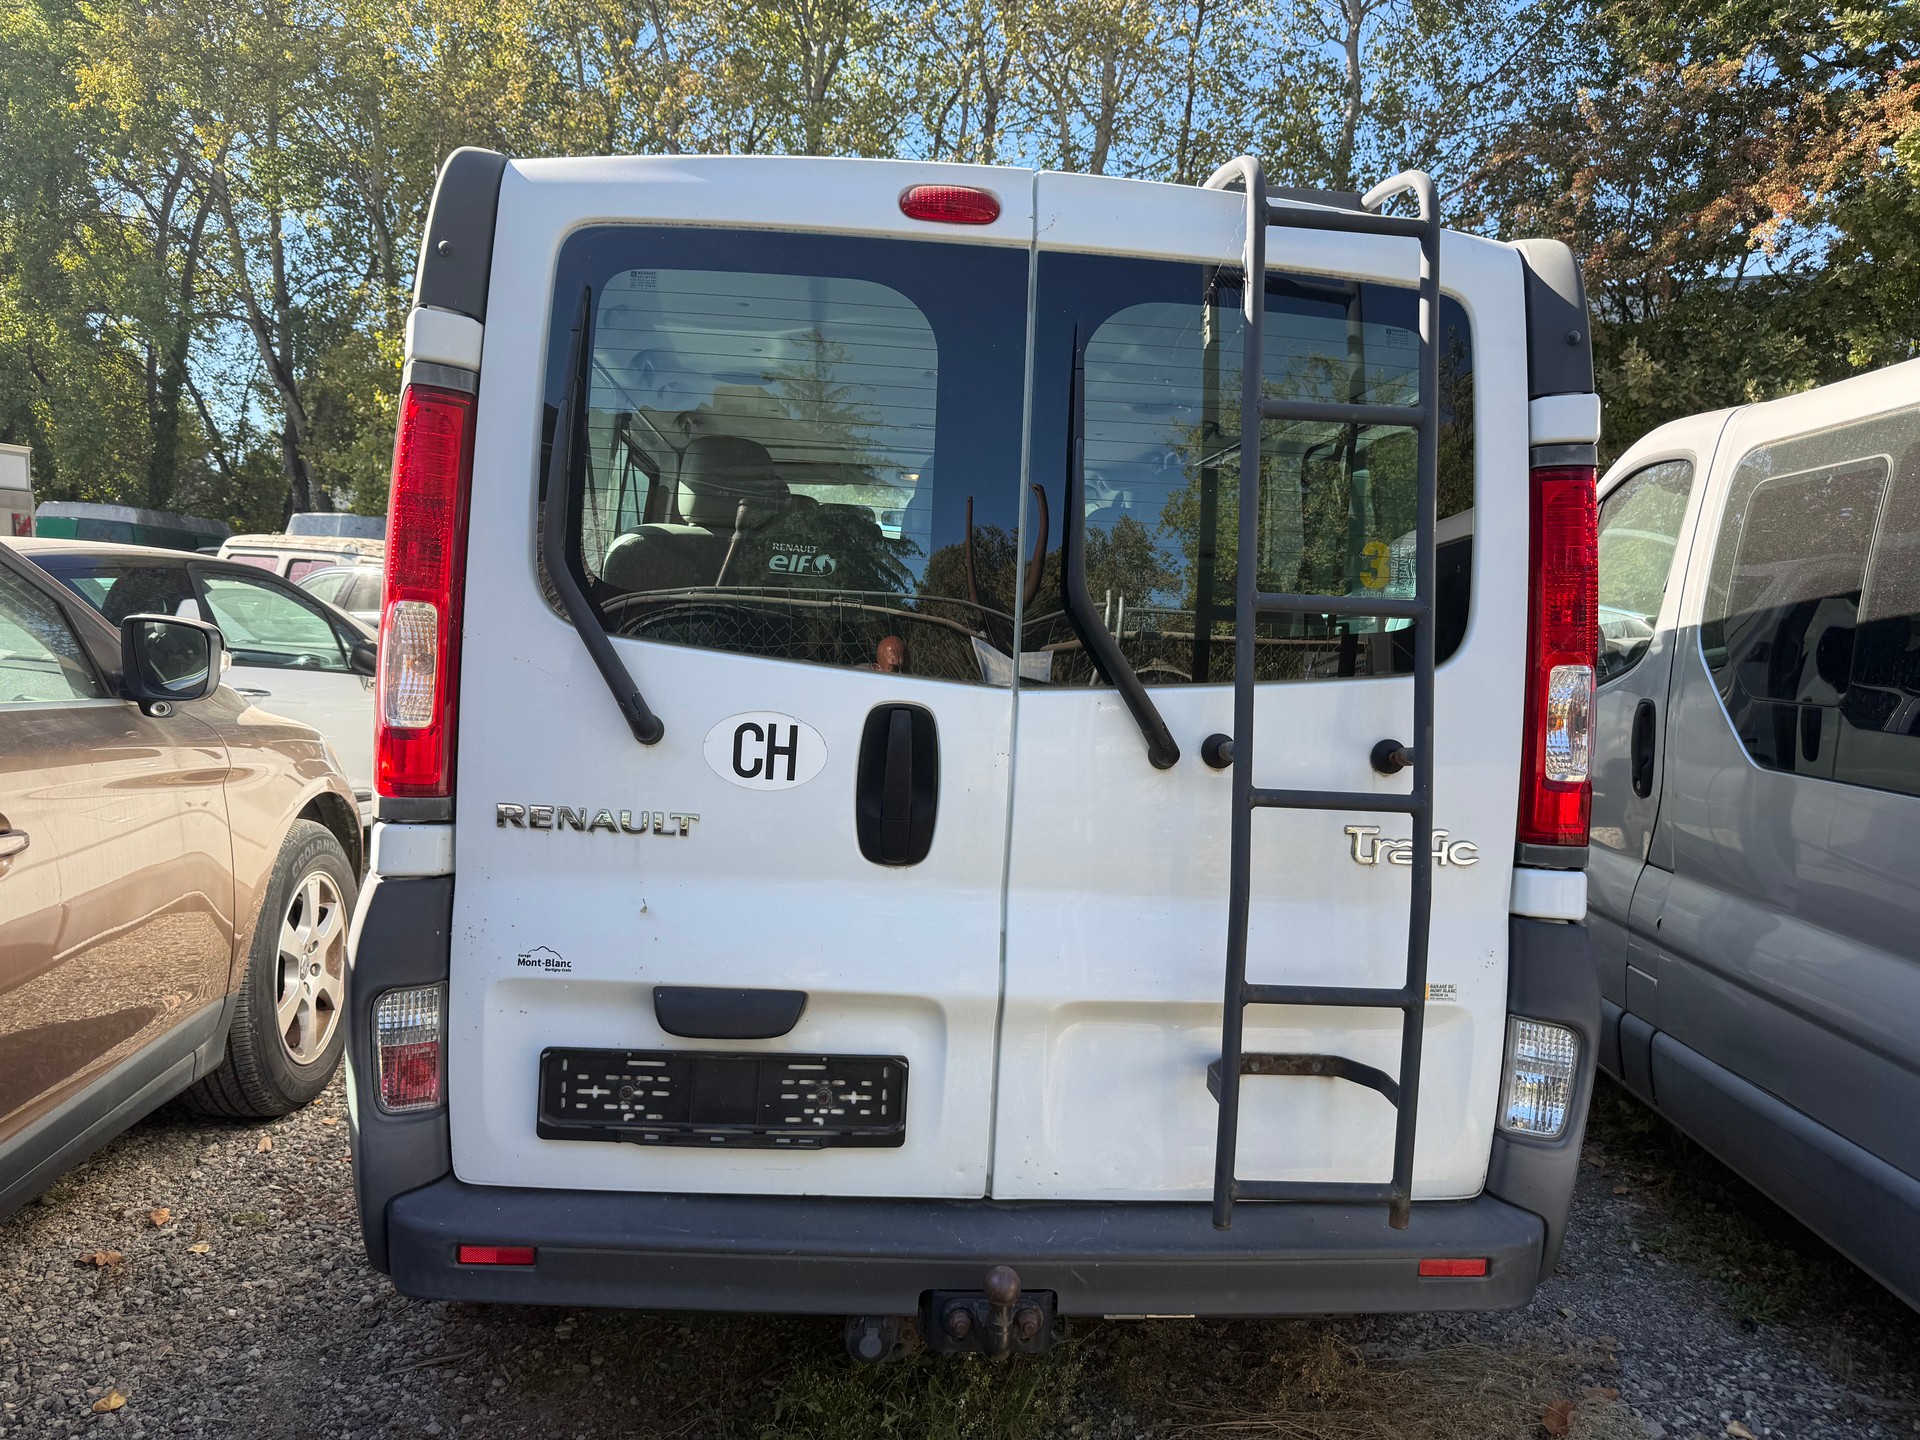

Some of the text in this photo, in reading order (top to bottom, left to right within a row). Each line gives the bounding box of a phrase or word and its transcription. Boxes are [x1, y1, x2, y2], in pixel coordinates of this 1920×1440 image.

[772, 542, 818, 554] RENAULT
[768, 554, 812, 573] elf
[1360, 541, 1390, 589] 3
[732, 722, 798, 781] CH
[496, 802, 700, 837] RENAULT
[517, 958, 571, 967] Mont-Blanc
